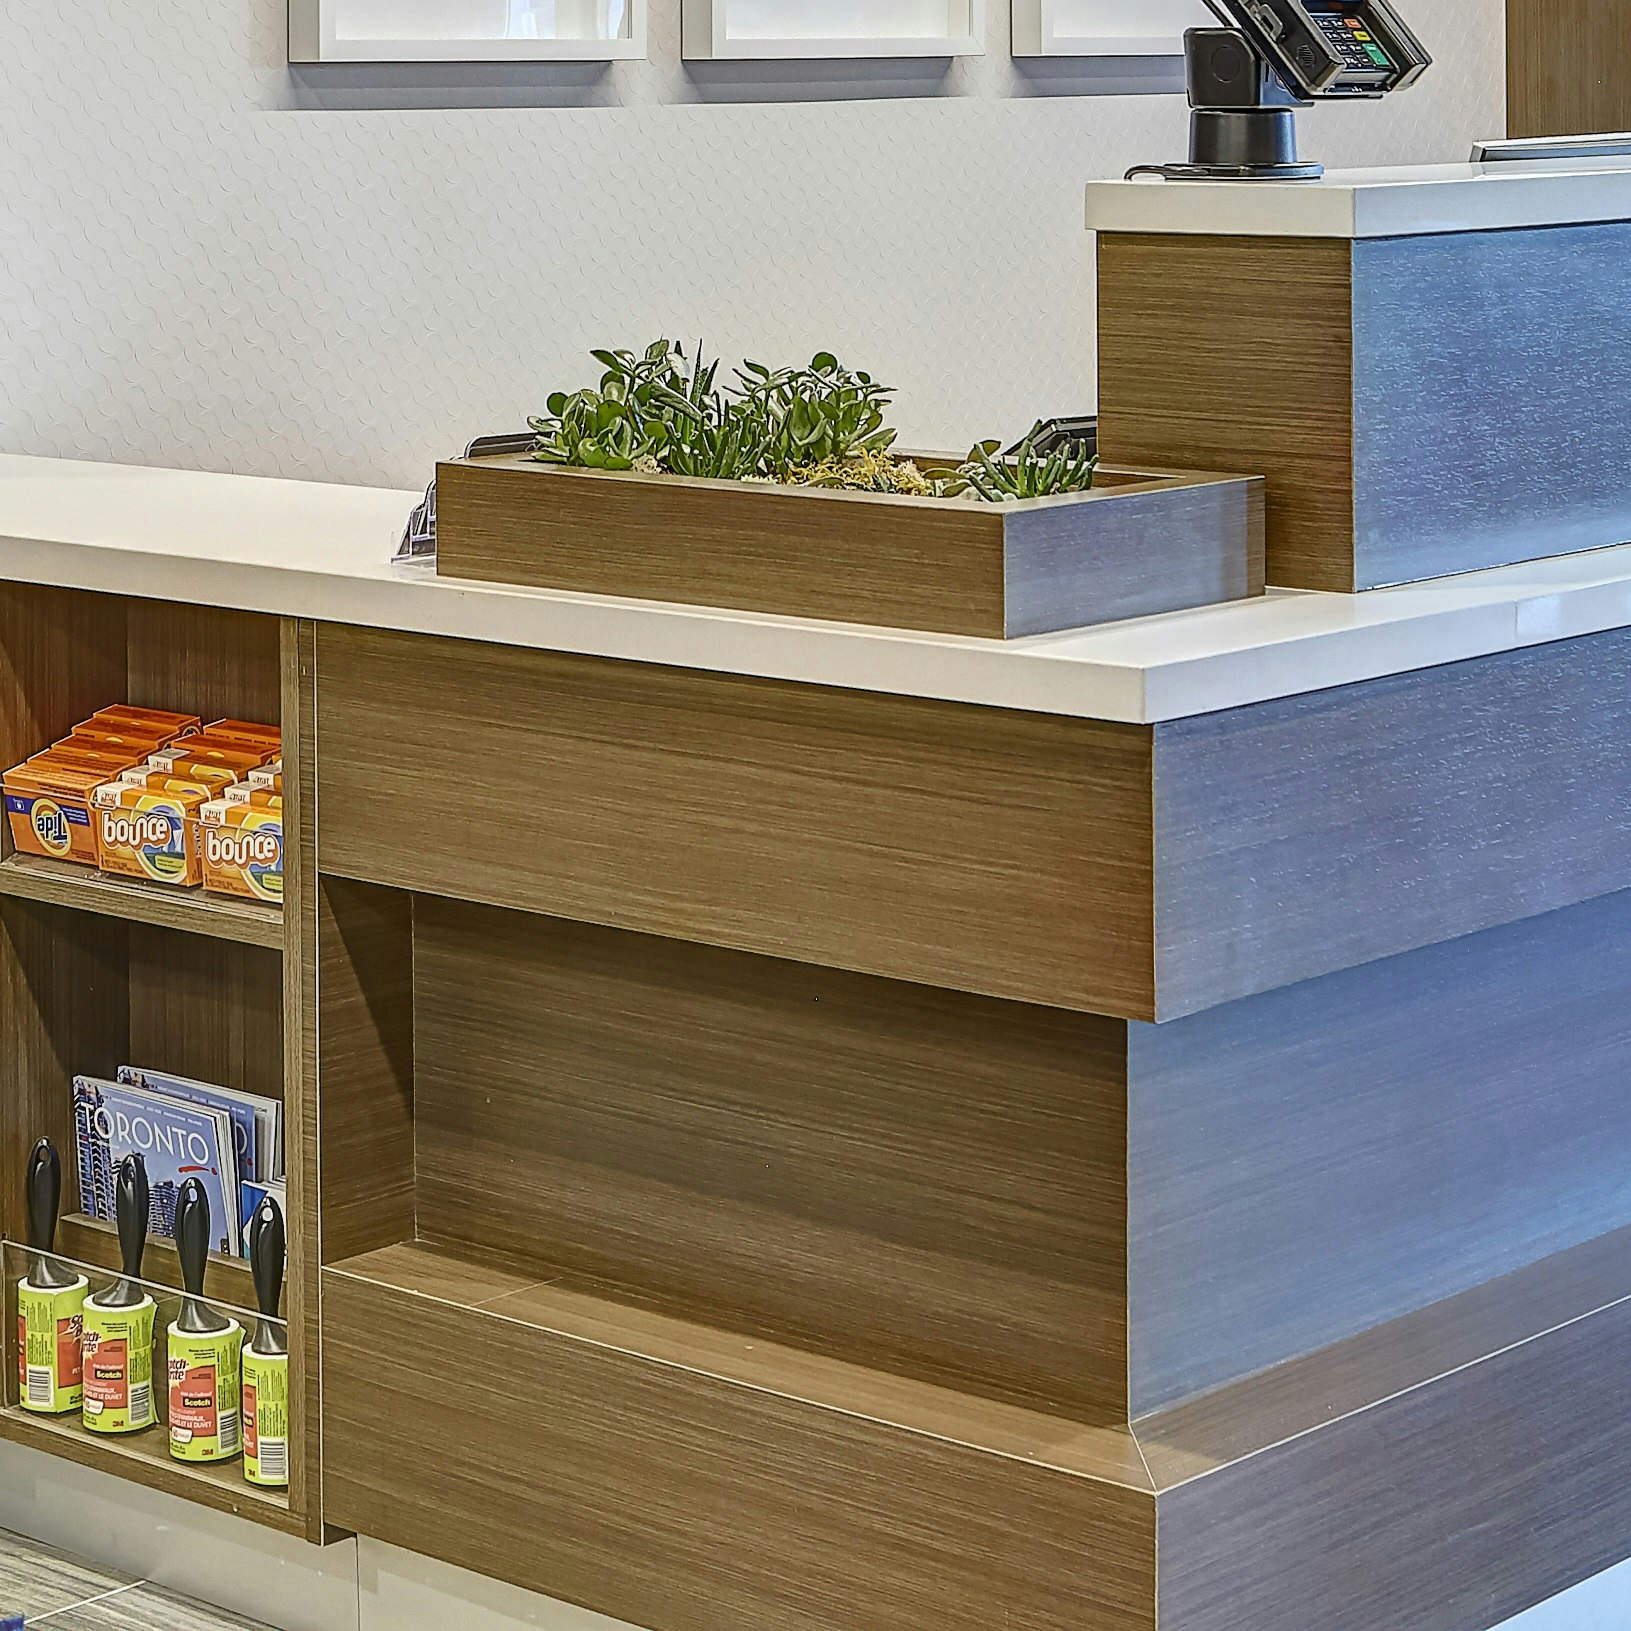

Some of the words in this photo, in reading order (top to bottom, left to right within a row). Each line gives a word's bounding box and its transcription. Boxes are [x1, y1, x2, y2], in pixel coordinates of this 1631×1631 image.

[103, 812, 169, 847] bounce
[206, 830, 278, 866] bounce
[75, 1101, 209, 1166] TORONTO
[82, 1330, 102, 1345] otch-
[168, 1357, 190, 1371] otch-
[96, 1370, 123, 1379] Scotch
[184, 1397, 211, 1407] Scotch
